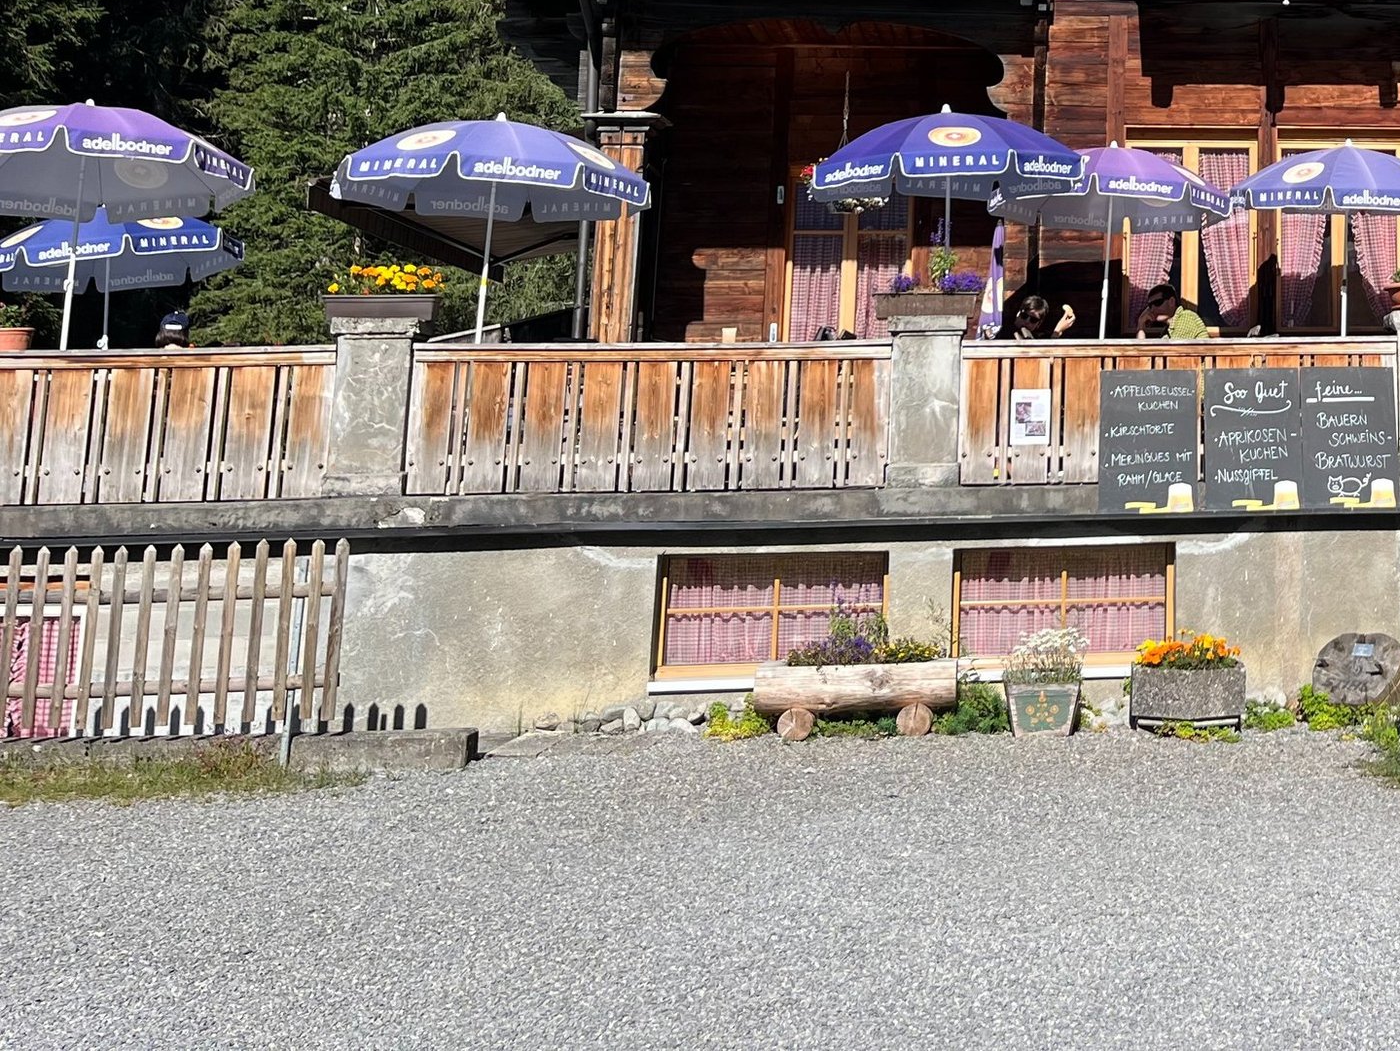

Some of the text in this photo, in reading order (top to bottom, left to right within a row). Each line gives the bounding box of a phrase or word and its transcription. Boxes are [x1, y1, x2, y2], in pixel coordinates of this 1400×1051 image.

[81, 133, 174, 156] adelbodner
[358, 157, 438, 173] MINERAL
[472, 157, 562, 181] adelbodner
[914, 154, 1000, 168] MINERAL
[1023, 155, 1073, 175] adelbodner
[824, 162, 884, 184] adelbodner
[590, 173, 640, 198] MINERAL
[1108, 175, 1173, 195] adelbodner
[1259, 191, 1320, 202] MINERAL
[140, 235, 209, 248] MINERAL
[1223, 381, 1248, 405] Soo
[1137, 400, 1179, 412] KUCHEN
[1316, 411, 1368, 430] BAUERN
[1111, 449, 1170, 467] MERINGUES
[1239, 445, 1289, 464] KUCHEN
[1314, 451, 1392, 470] BRATWURST
